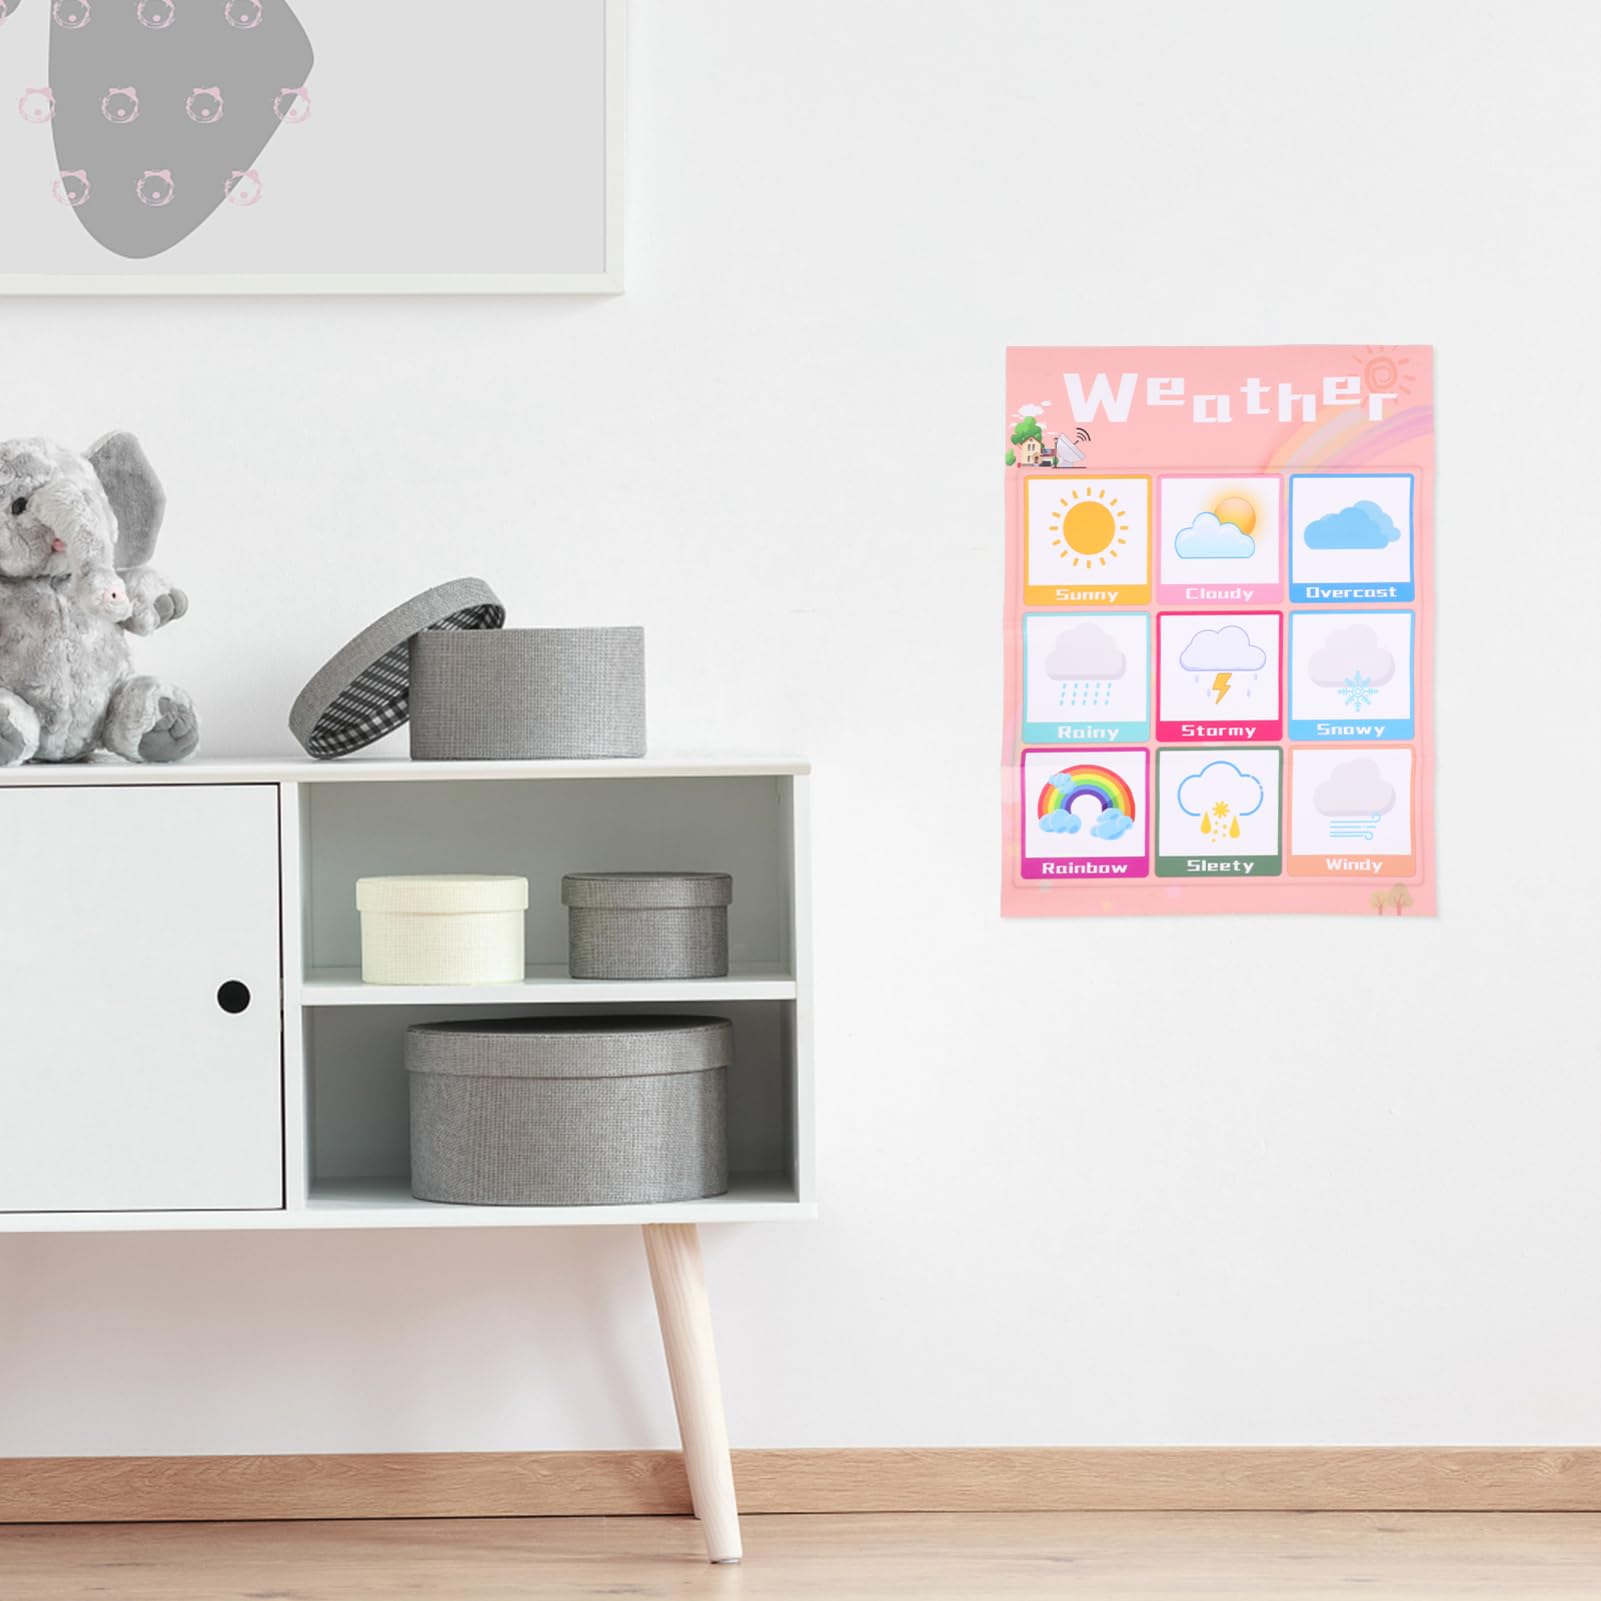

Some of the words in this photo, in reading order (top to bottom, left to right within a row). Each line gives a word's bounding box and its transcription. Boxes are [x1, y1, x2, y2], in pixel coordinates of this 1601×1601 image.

[1063, 372, 1400, 423] Weather
[1055, 588, 1119, 603] Sunny
[1185, 586, 1255, 602] Cloudy
[1305, 586, 1398, 600] Overcast
[1057, 725, 1120, 741] Rainy
[1181, 723, 1257, 739] Stormy
[1316, 722, 1386, 738] Snowy
[1041, 861, 1128, 876] Rainbow
[1187, 858, 1255, 874] Sleety
[1325, 857, 1383, 873] Windy
